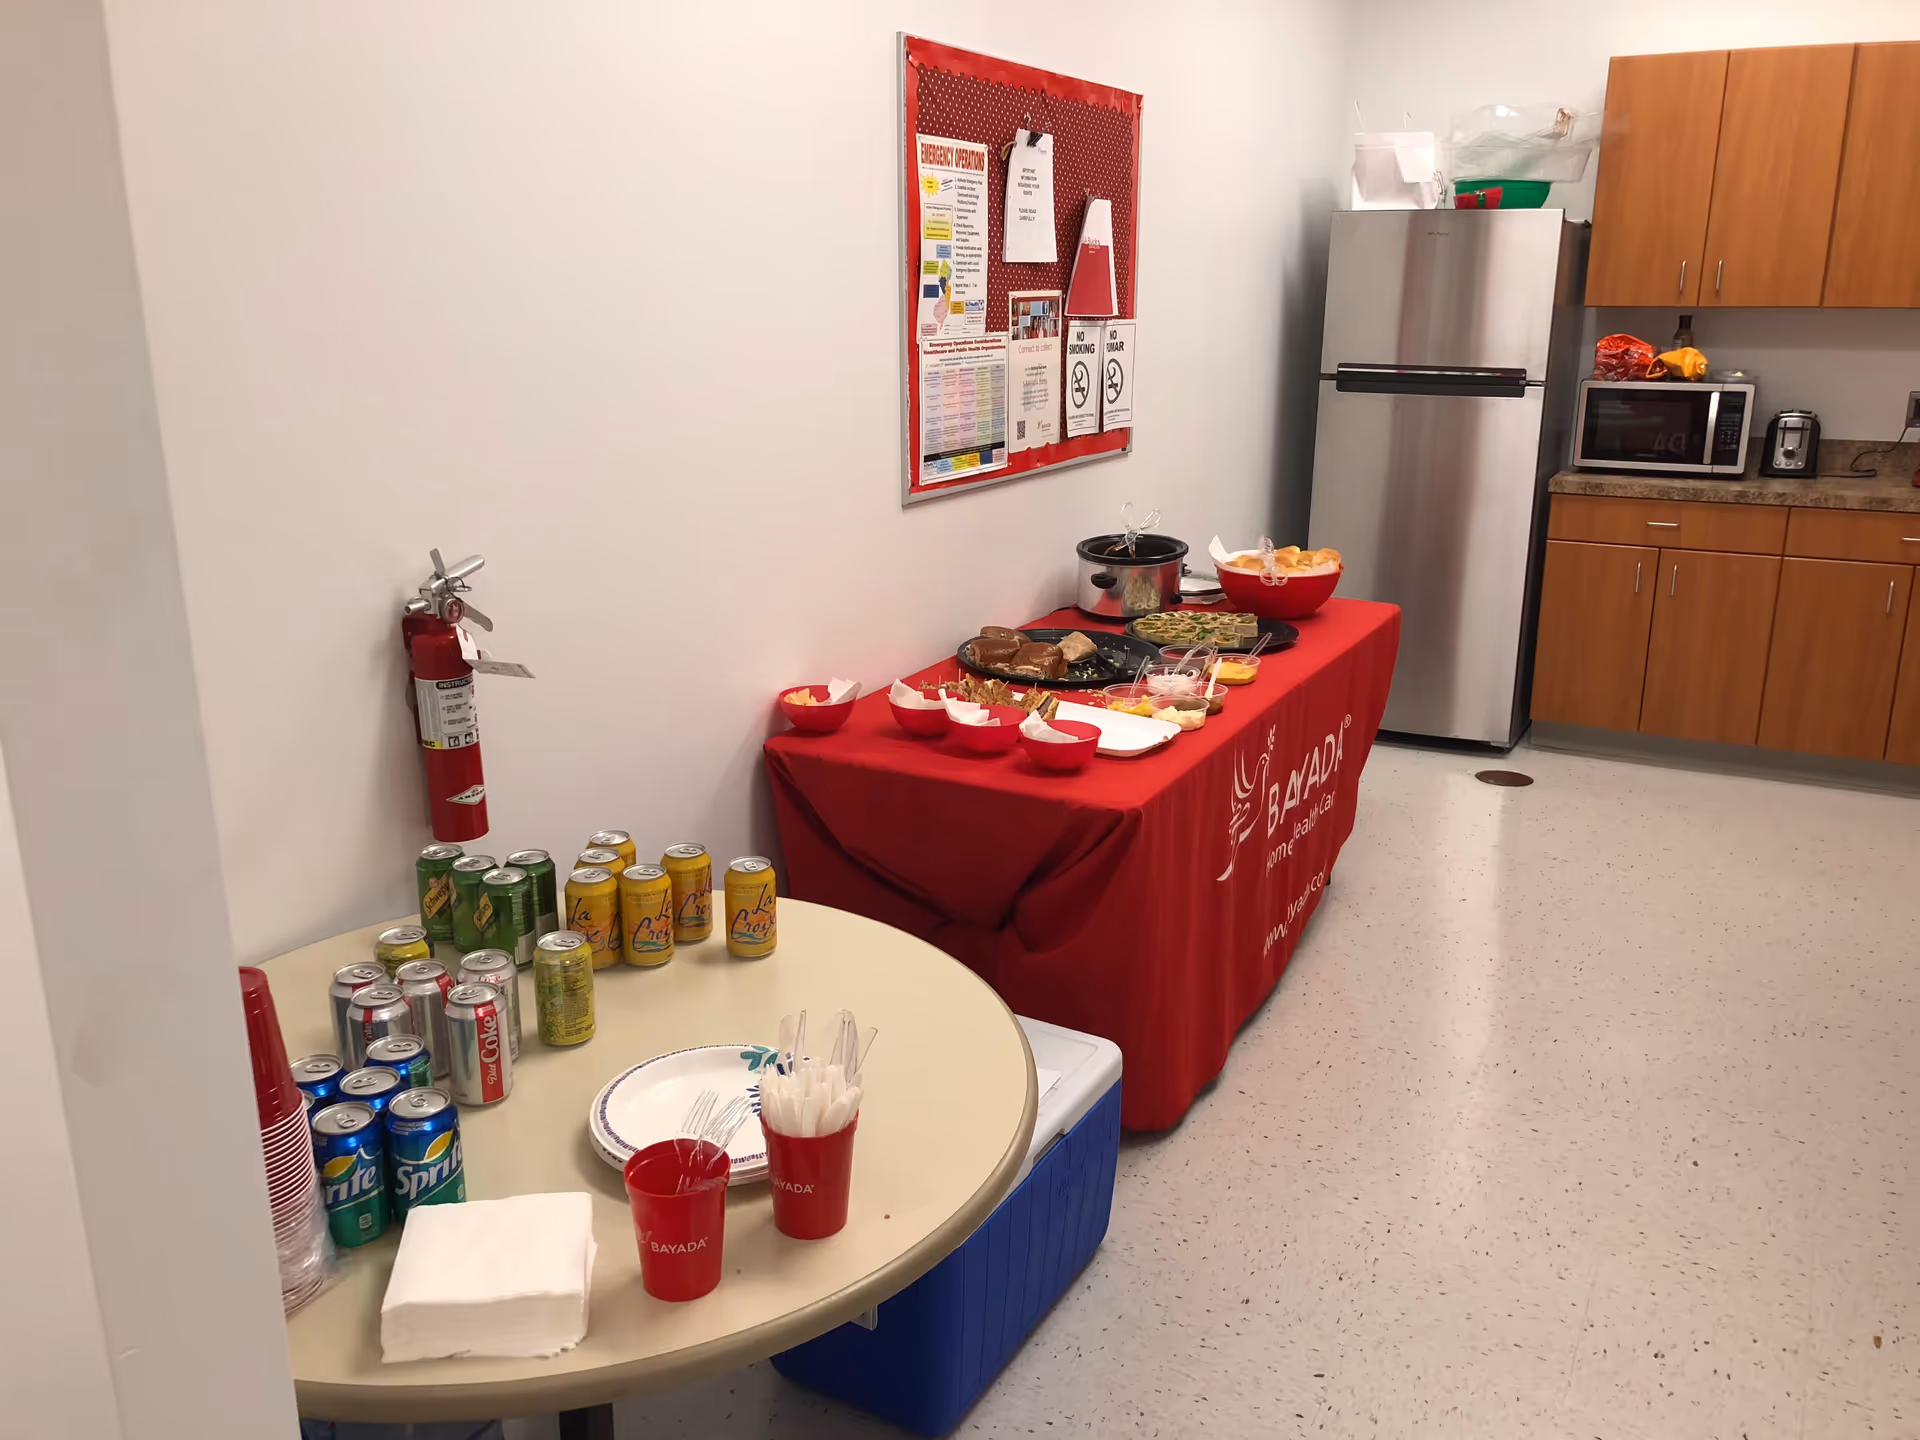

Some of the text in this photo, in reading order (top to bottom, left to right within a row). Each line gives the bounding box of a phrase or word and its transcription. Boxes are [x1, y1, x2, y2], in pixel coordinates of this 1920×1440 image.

[921, 143, 985, 172] EMERGENCY OPERATIONS
[1068, 343, 1095, 355] SMOKING
[1076, 331, 1085, 342] NO
[1109, 329, 1118, 340] NO
[1018, 345, 1036, 354] Connect
[570, 896, 593, 925] La
[752, 883, 773, 915] La
[480, 1014, 499, 1085] Diet Coke
[326, 1161, 377, 1205] rite
